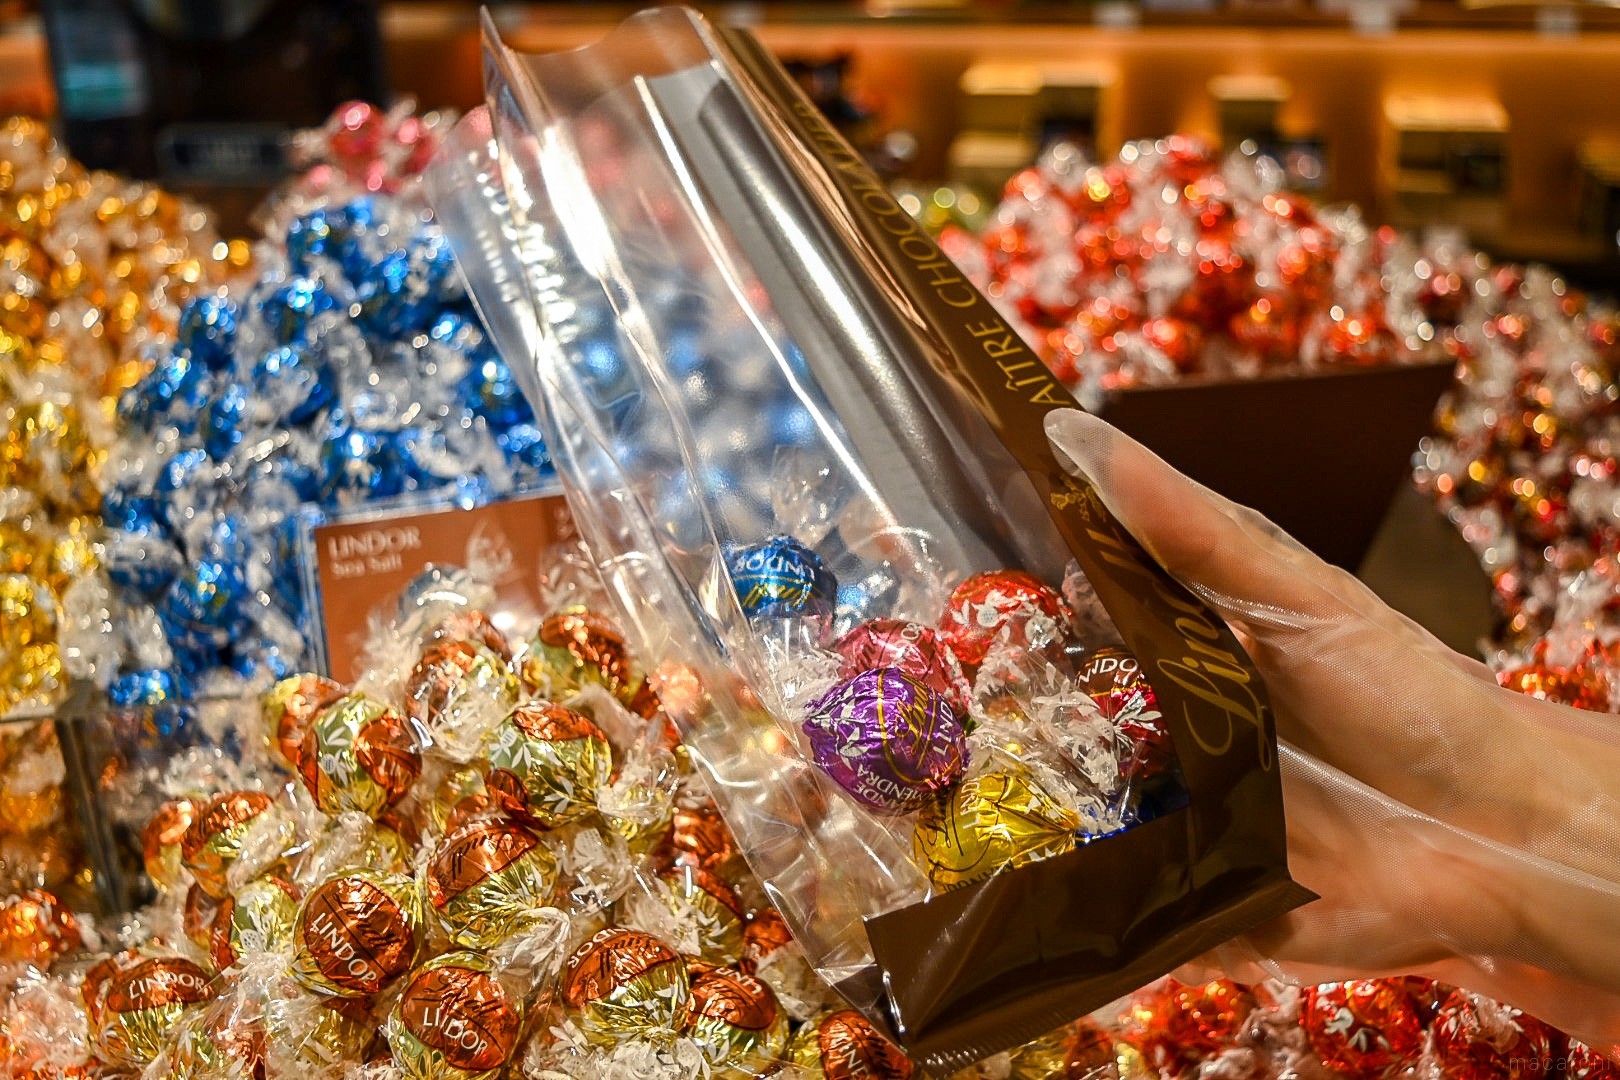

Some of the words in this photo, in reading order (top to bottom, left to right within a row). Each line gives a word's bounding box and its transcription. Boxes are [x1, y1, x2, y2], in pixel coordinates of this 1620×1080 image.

[965, 317, 1071, 405] AÎTRE
[328, 526, 421, 559] LINDOR
[331, 558, 365, 578] Sea
[367, 553, 402, 575] Salt
[933, 701, 955, 757] LIND
[567, 927, 629, 969] NDOR
[129, 971, 206, 999] LINDOR
